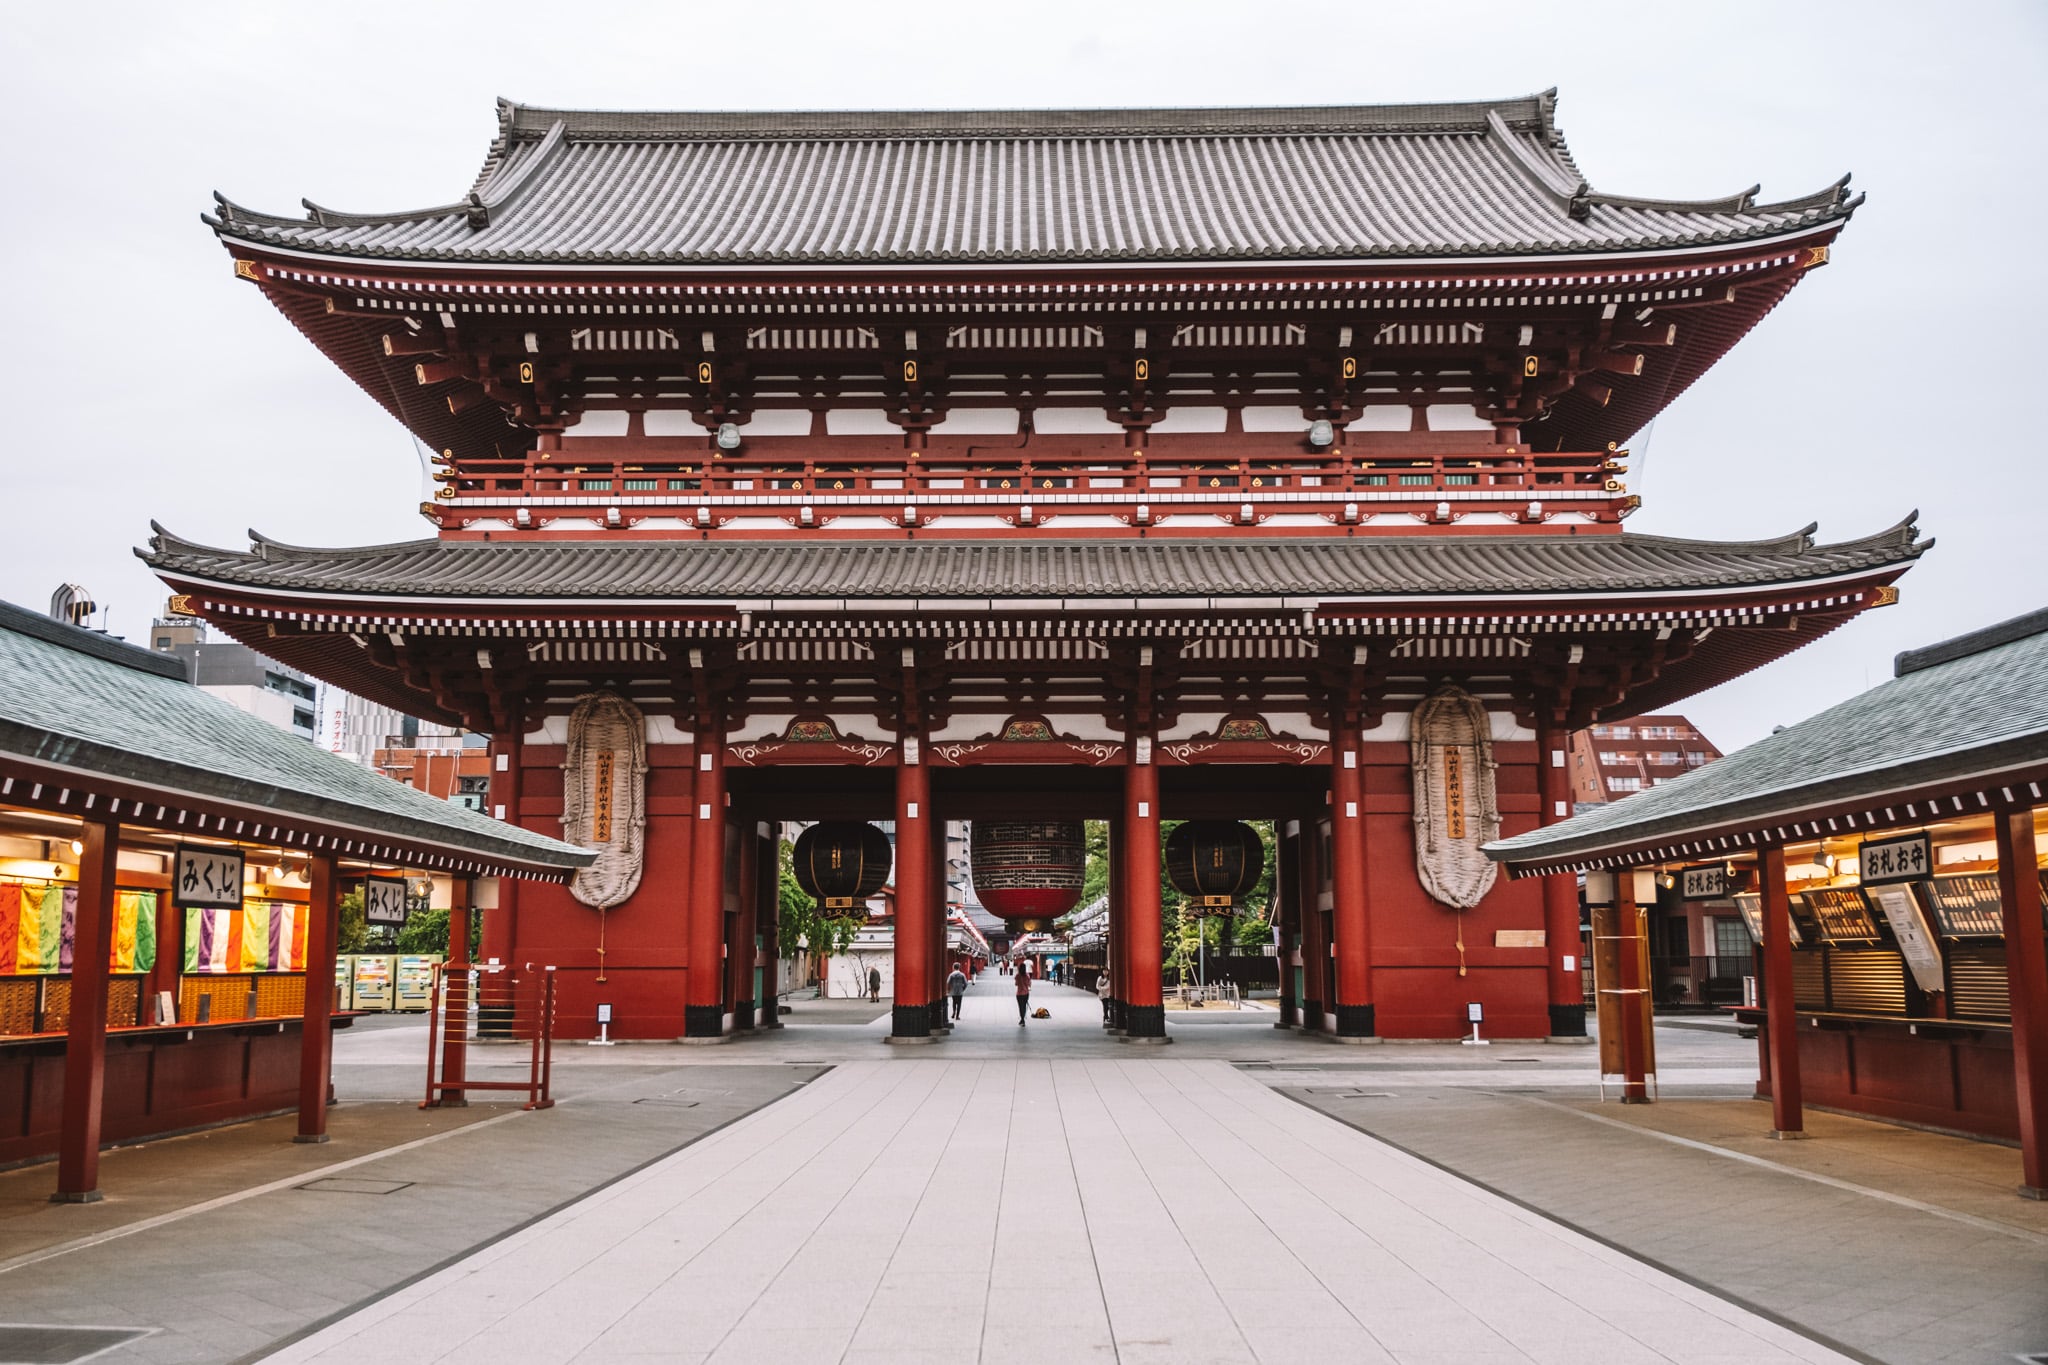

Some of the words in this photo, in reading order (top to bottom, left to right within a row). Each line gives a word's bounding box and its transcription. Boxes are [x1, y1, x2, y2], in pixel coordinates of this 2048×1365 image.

[332, 710, 342, 750] カラオケ
[183, 858, 235, 894] みくじ
[1867, 843, 1924, 876] お札お守
[1687, 871, 1723, 895] お札お守
[370, 886, 401, 914] みくじ
